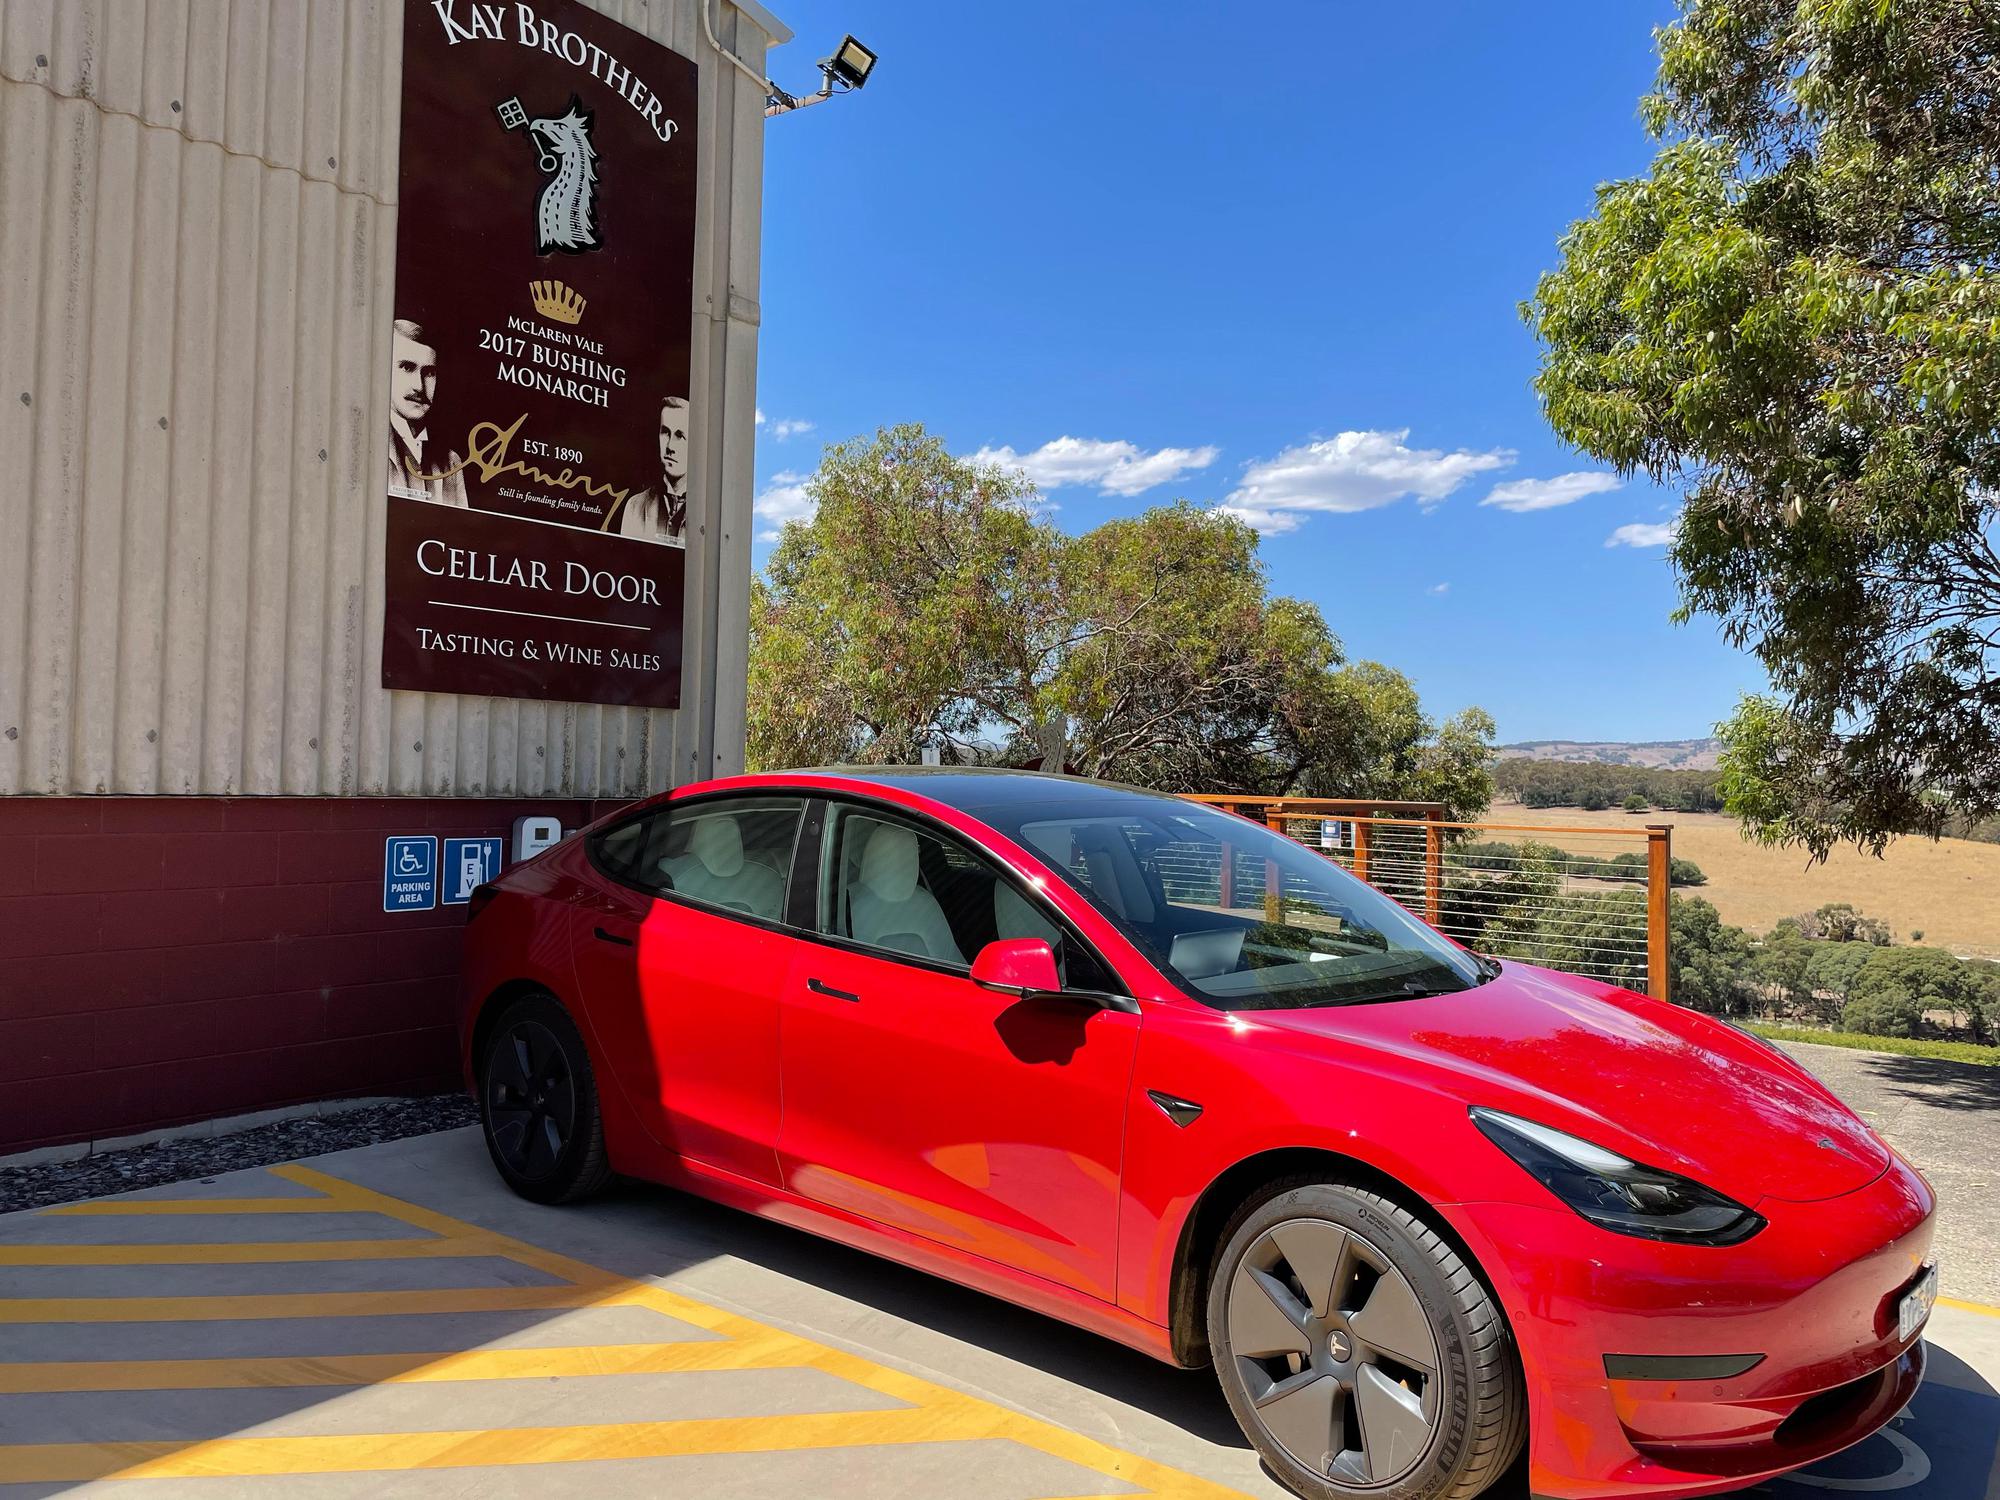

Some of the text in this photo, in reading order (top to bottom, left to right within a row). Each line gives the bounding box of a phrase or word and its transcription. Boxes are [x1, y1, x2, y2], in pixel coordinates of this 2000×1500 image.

[431, 0, 679, 142] KAY BROTHERS
[479, 329, 627, 387] 2017 BUSHING
[575, 335, 604, 355] VALE
[497, 361, 609, 408] MONARCH
[523, 439, 583, 465] EST. 1890
[498, 487, 603, 515] Still in founding family hands.
[416, 539, 661, 606] CELLAR DOOR
[416, 628, 661, 671] TASTING & WINE SALES
[391, 882, 431, 893] PARKING
[398, 894, 423, 904] AREA
[1441, 1352, 1467, 1467] MICHELIN
